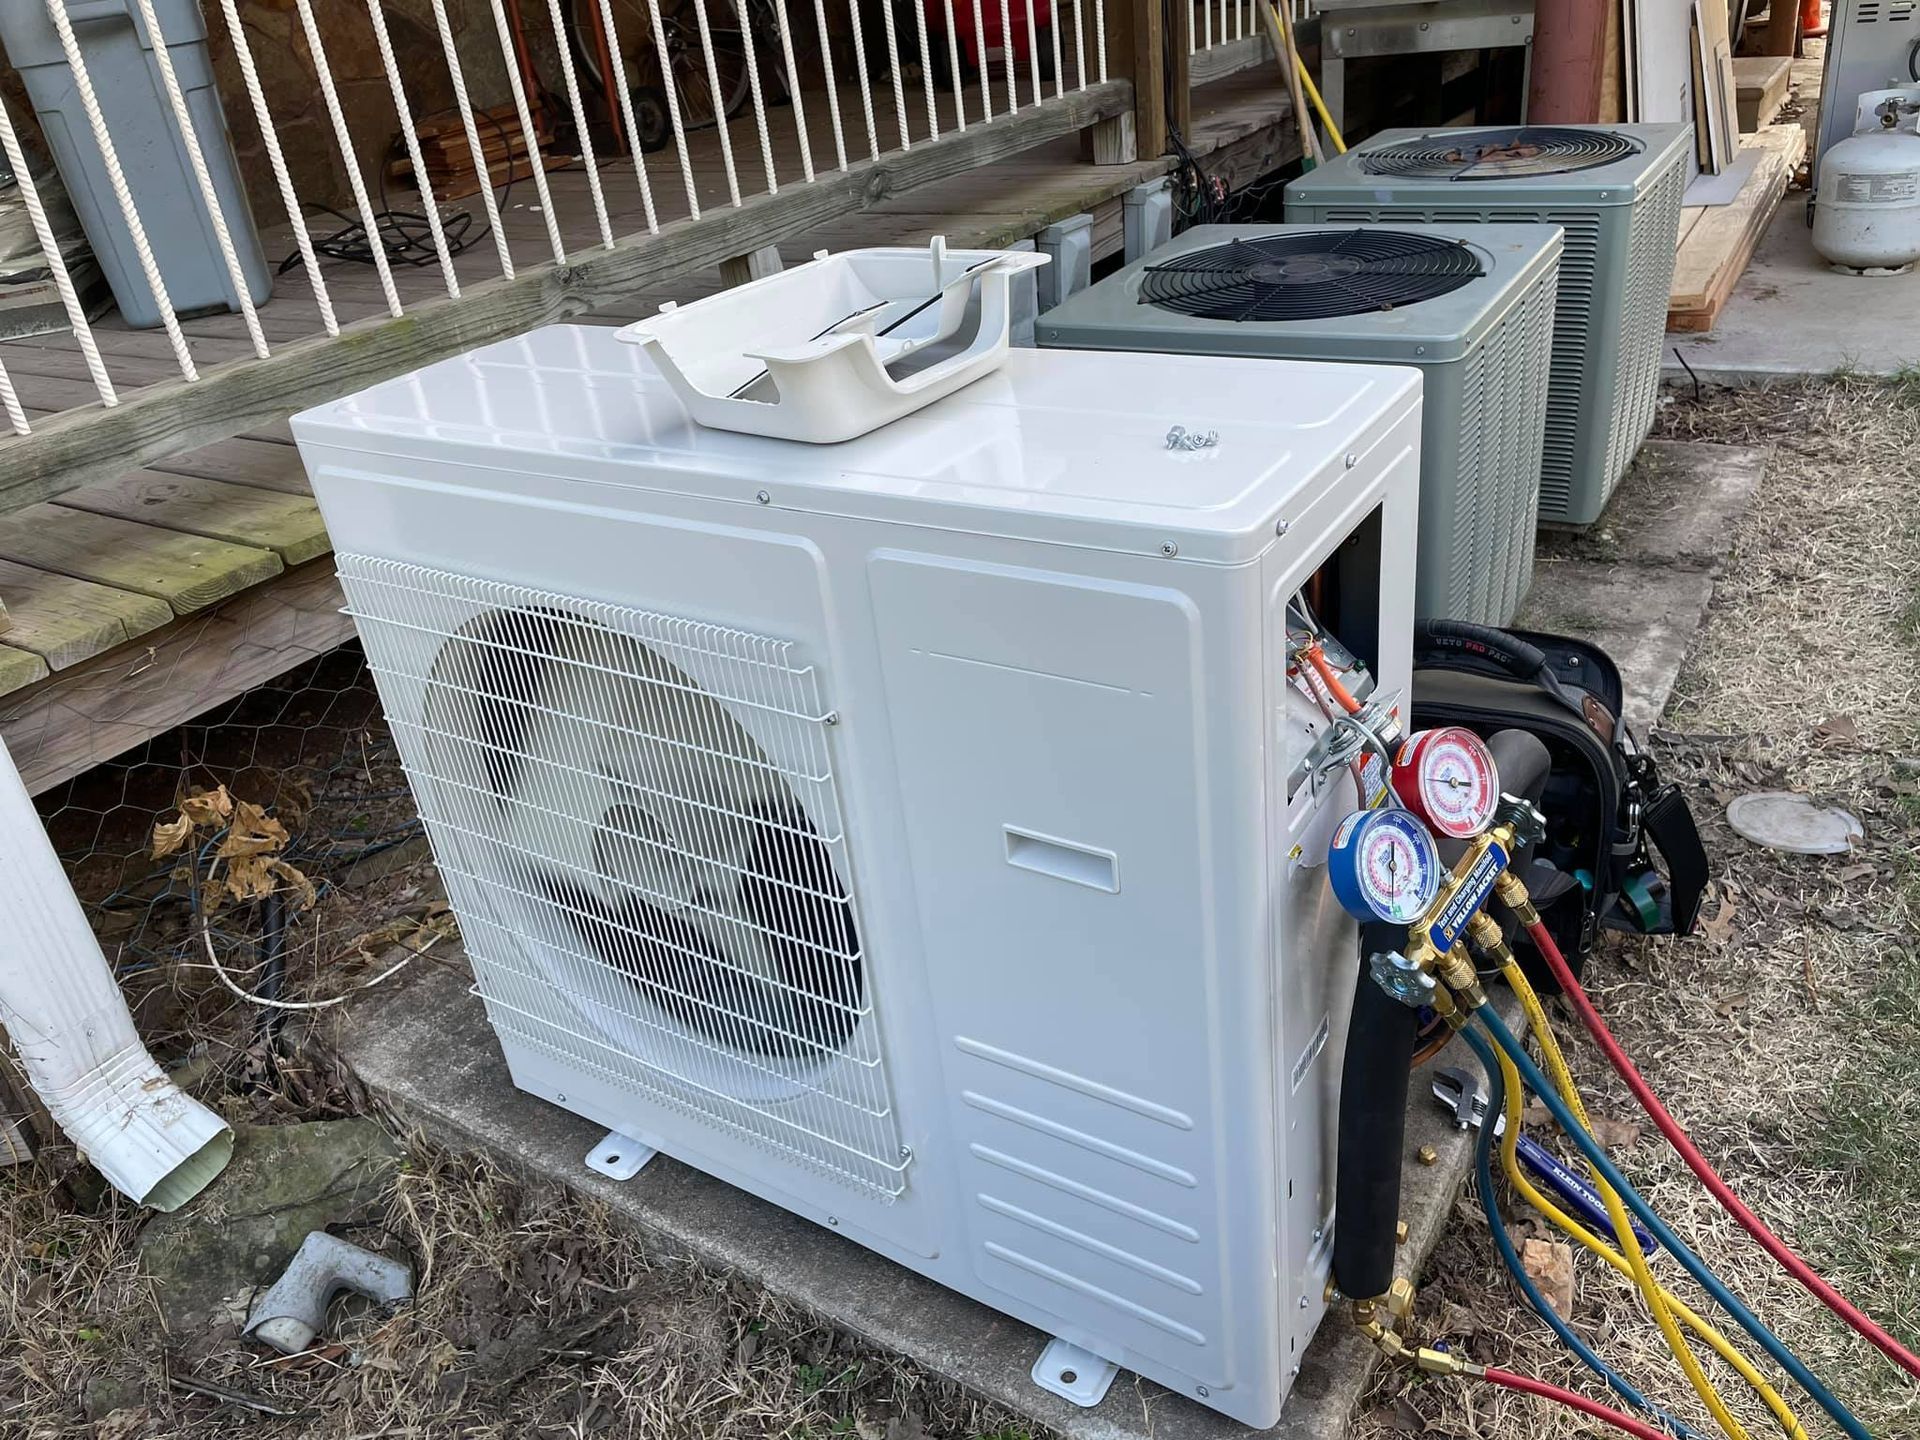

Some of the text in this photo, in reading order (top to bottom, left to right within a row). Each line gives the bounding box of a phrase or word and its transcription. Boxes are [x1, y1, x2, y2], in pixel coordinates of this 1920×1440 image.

[1435, 638, 1462, 647] VETO
[1465, 641, 1486, 653] PRO
[1437, 851, 1494, 929] Test and Charging Manifold
[1452, 862, 1499, 929] YELLOW JACKET
[1552, 1167, 1582, 1192] KLEIN
